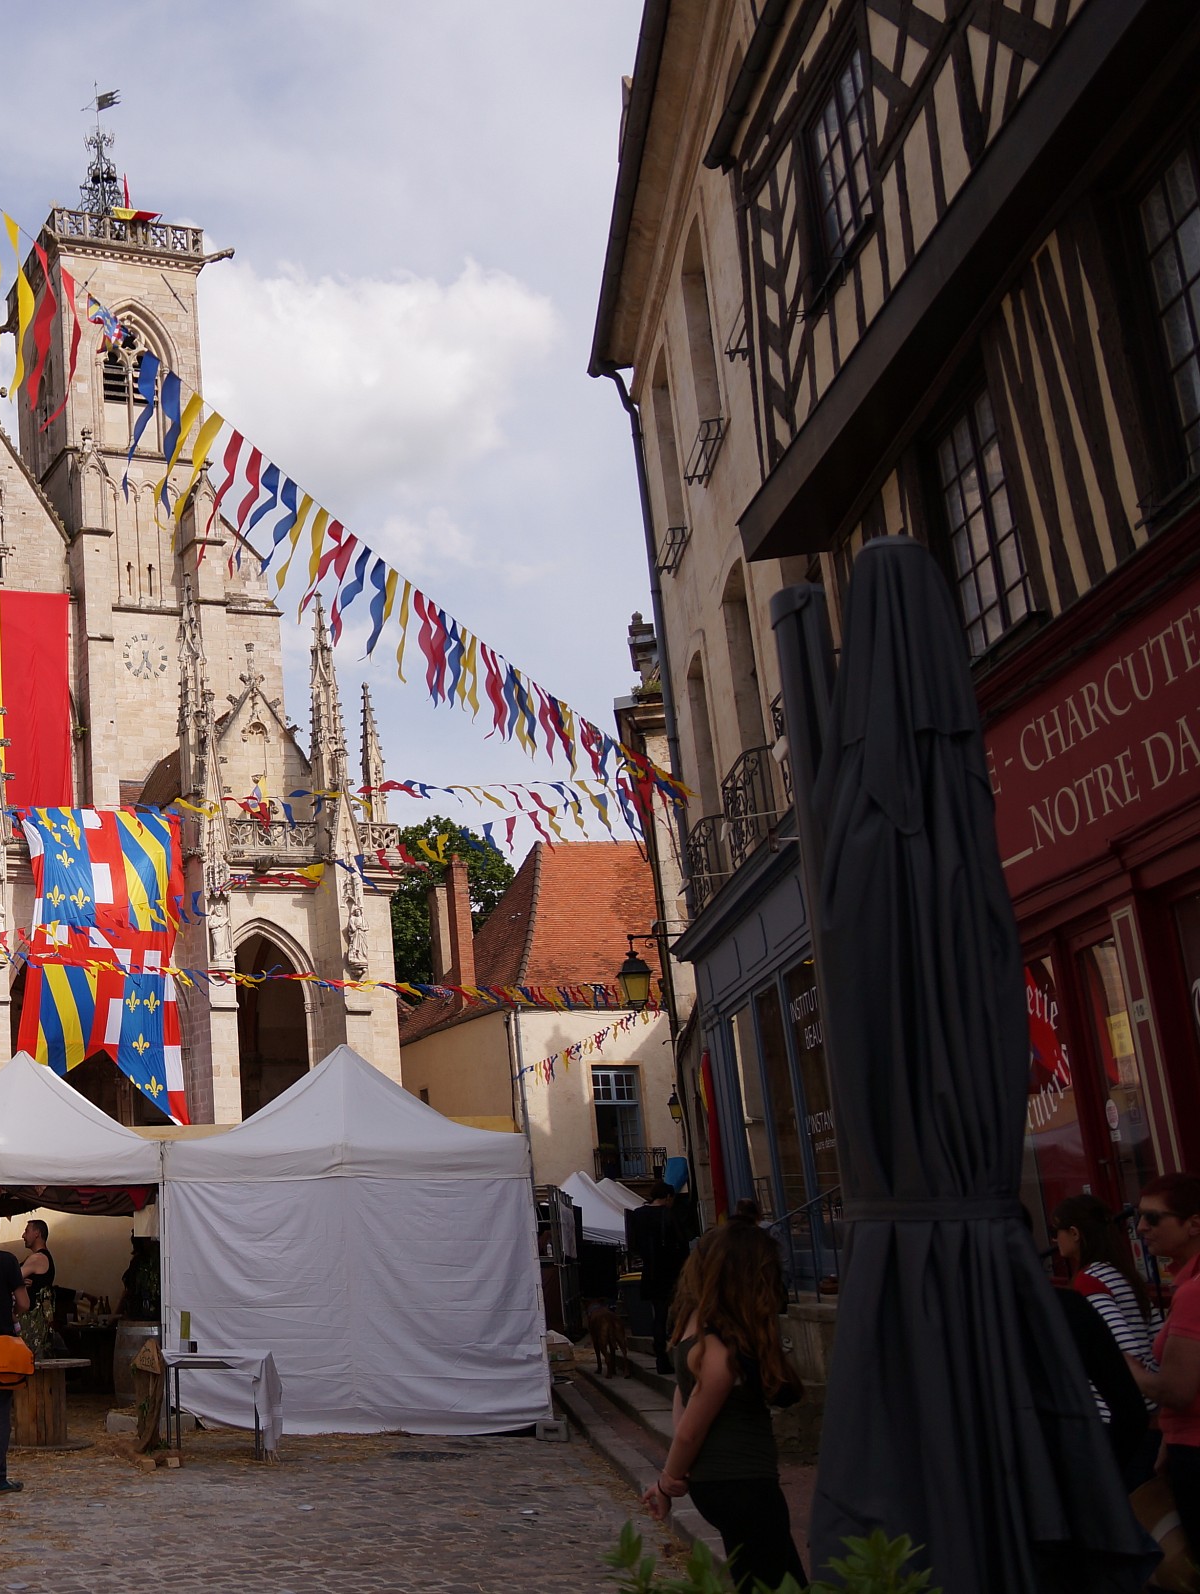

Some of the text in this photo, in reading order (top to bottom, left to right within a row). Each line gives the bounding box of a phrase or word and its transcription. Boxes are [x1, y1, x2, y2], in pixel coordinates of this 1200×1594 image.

[1020, 604, 1200, 772] CHARCUTE
[1028, 706, 1200, 851] NOTRE DA
[1025, 983, 1059, 1031] erie
[805, 1021, 823, 1050] BEAU
[805, 1109, 834, 1137] L'INSTAN
